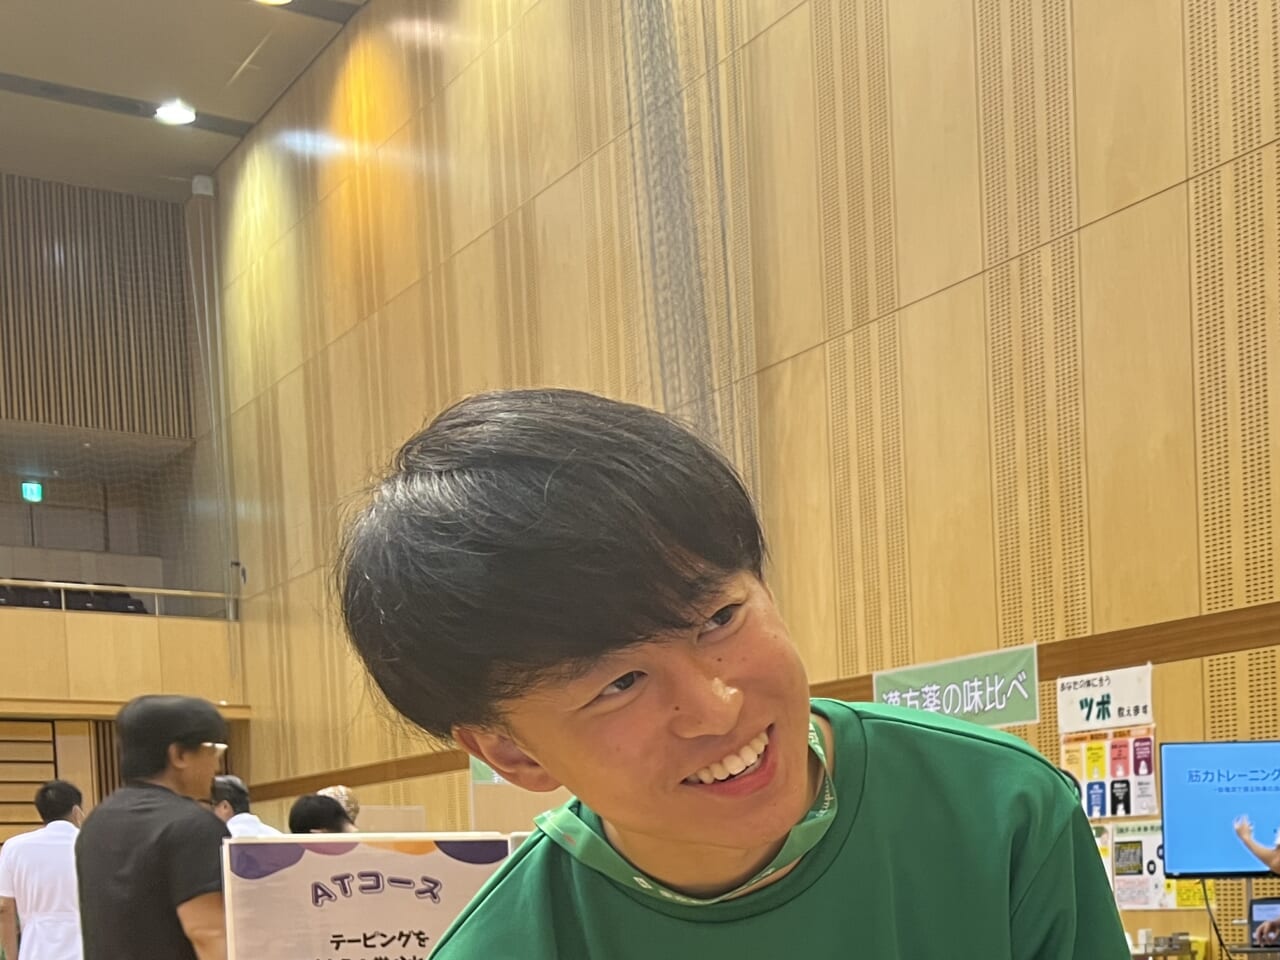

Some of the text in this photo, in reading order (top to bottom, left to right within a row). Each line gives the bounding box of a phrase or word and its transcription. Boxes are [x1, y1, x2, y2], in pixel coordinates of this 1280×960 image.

[1079, 693, 1111, 721] ツボ
[310, 871, 442, 907] ATコース
[330, 930, 429, 950] テーピングを
